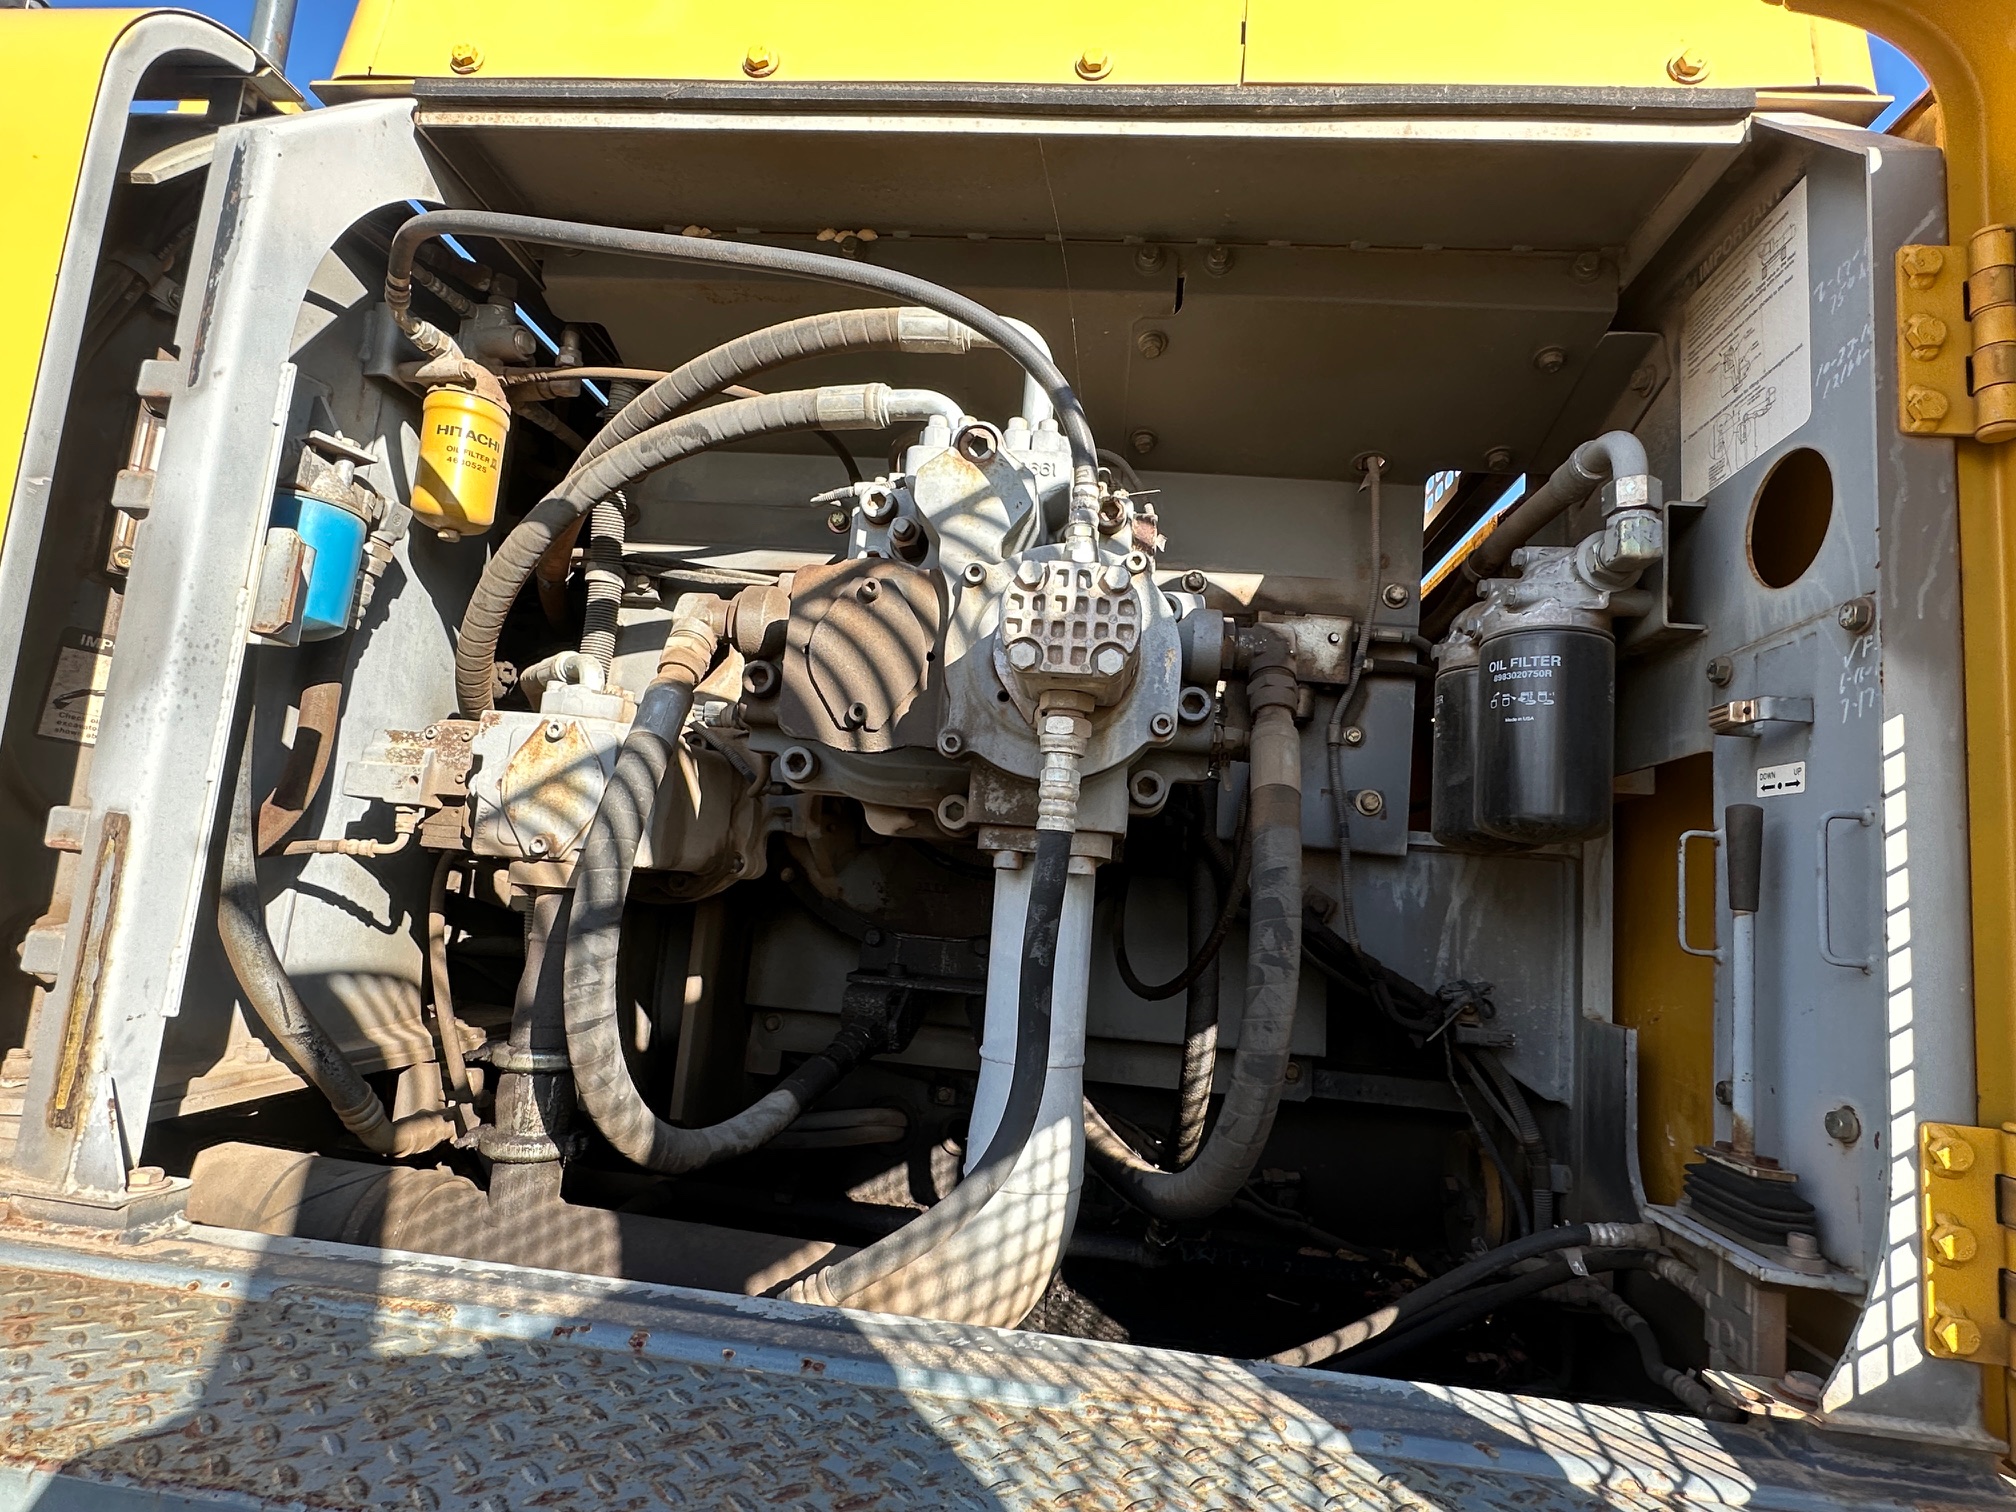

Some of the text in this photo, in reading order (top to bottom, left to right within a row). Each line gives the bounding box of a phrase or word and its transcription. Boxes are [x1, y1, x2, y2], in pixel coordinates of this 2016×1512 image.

[436, 424, 500, 454] HITACHI
[446, 445, 490, 464] OIL FILTER
[81, 633, 116, 651] IMP
[1488, 655, 1562, 673] OIL FILTER
[1759, 766, 1803, 781] DOWN UP
